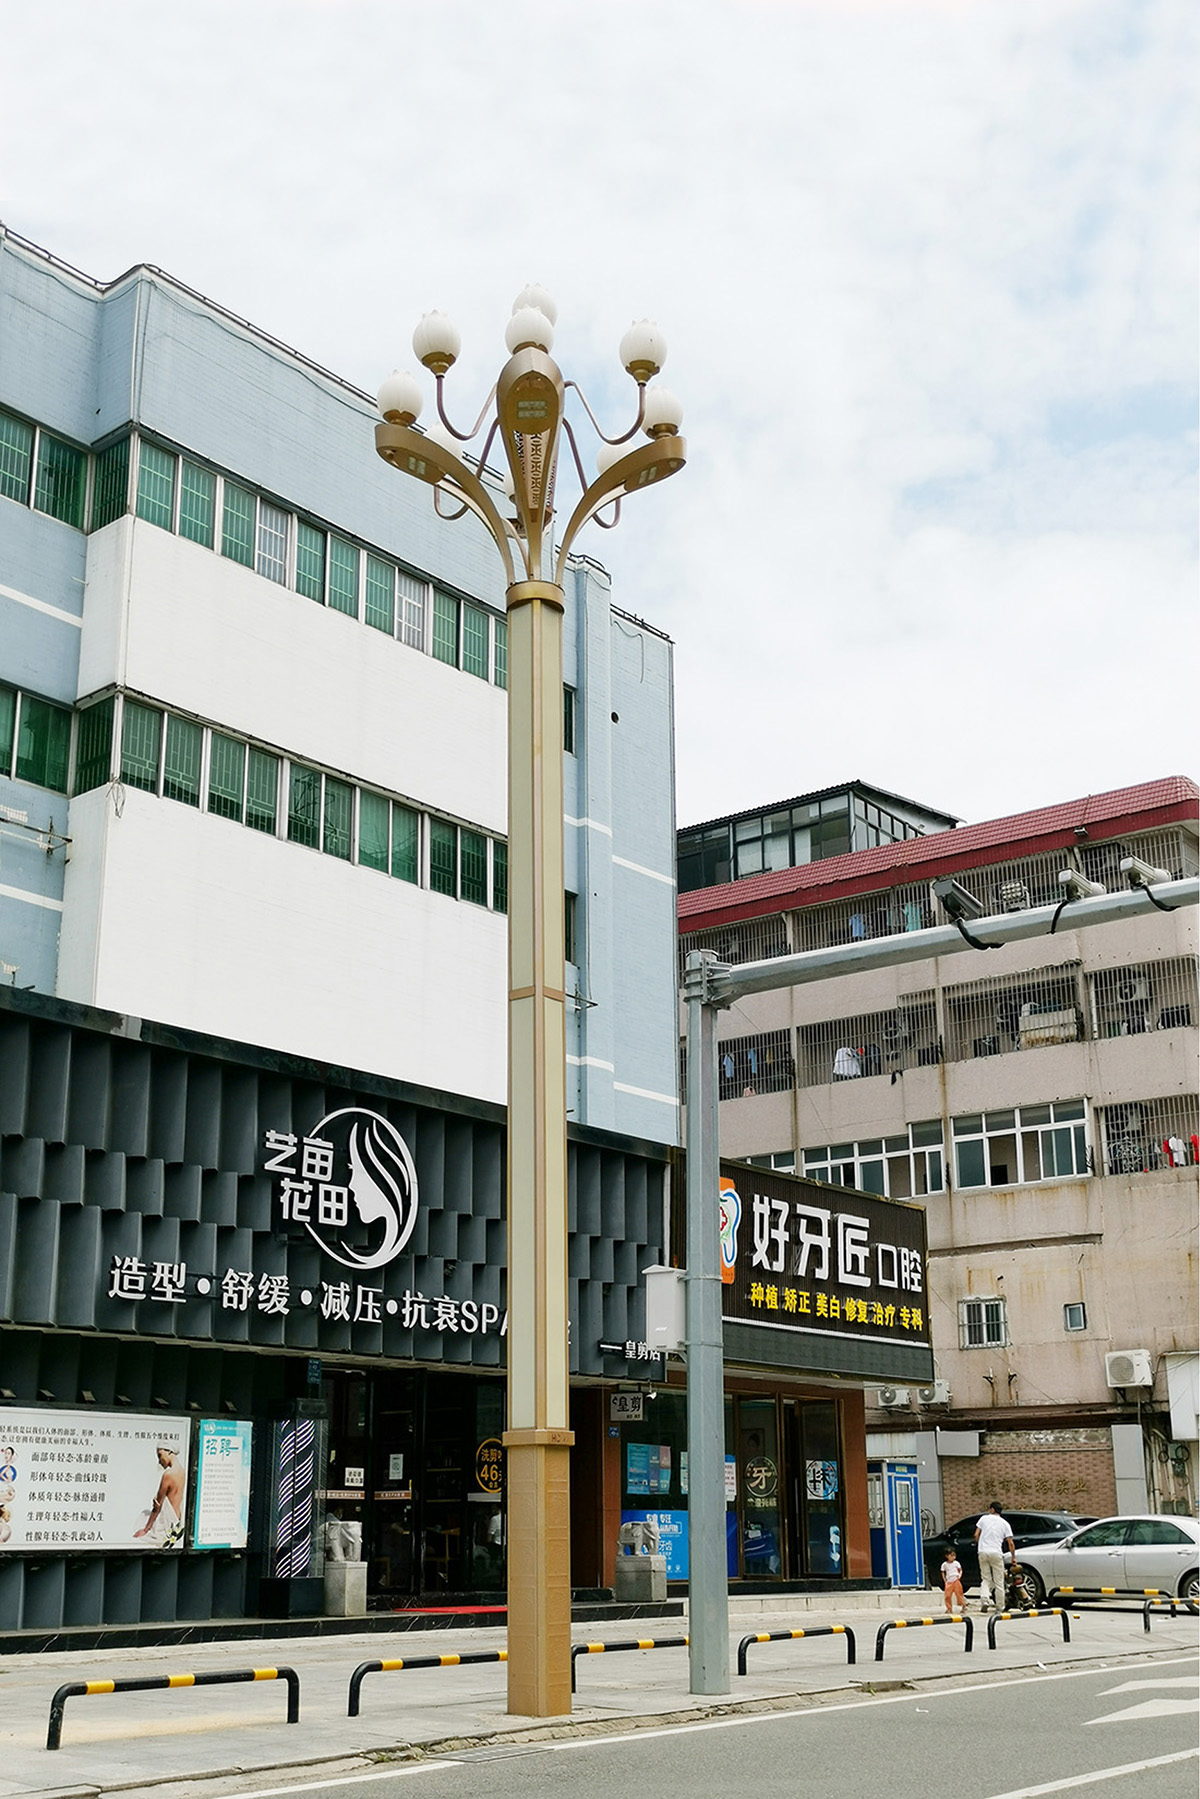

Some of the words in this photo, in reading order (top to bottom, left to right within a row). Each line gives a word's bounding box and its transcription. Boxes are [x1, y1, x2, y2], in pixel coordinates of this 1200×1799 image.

[264, 1130, 334, 1182] 艺亩
[280, 1177, 349, 1226] 花田
[752, 1193, 923, 1293] 好牙匠口腔
[750, 1282, 779, 1310] 种植
[784, 1286, 811, 1313] 矫正
[816, 1293, 841, 1319] 美白
[844, 1297, 868, 1323] 修复
[873, 1302, 896, 1328] 治疗
[899, 1305, 923, 1331] 专科
